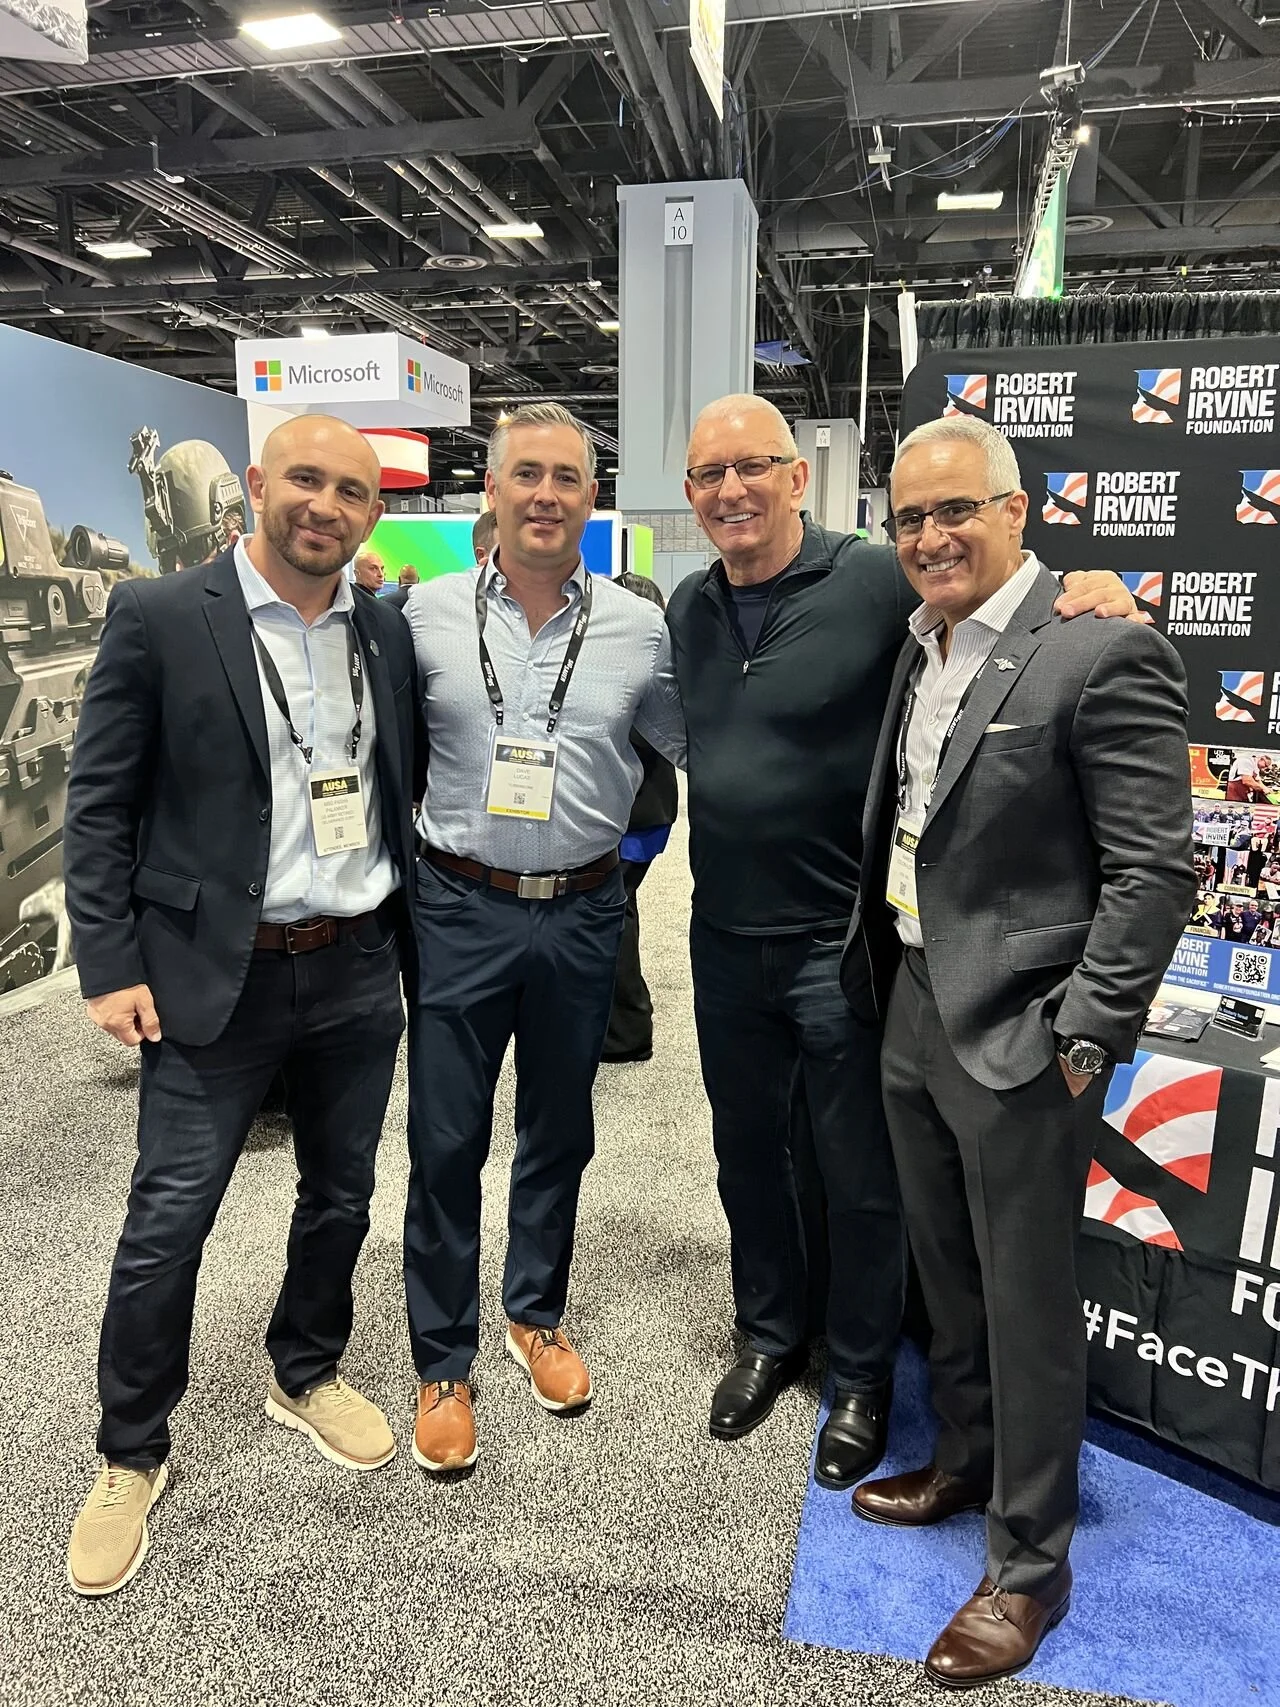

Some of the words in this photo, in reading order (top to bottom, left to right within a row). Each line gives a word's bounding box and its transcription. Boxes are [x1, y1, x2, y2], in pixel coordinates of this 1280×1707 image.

[674, 207, 684, 221] A
[671, 225, 687, 240] 10
[288, 360, 380, 385] Microsoft
[995, 372, 1078, 395] ROBERT
[1190, 364, 1280, 390] ROBERT
[423, 370, 464, 405] Microsoft
[993, 396, 1076, 423] IRVINE
[1187, 389, 1277, 419] IRVINE
[1185, 419, 1274, 435] FOUNDATION
[1096, 471, 1181, 494] ROBERT
[1093, 495, 1178, 522] IRVINE
[1092, 523, 1175, 537] FOUNDATION
[1171, 571, 1257, 594] ROBERT
[1168, 595, 1254, 621] IRVINE
[1167, 622, 1251, 637] FOUNDATION
[322, 780, 348, 792] AUSA
[1176, 937, 1212, 954] BERT
[1172, 949, 1210, 969] VINE
